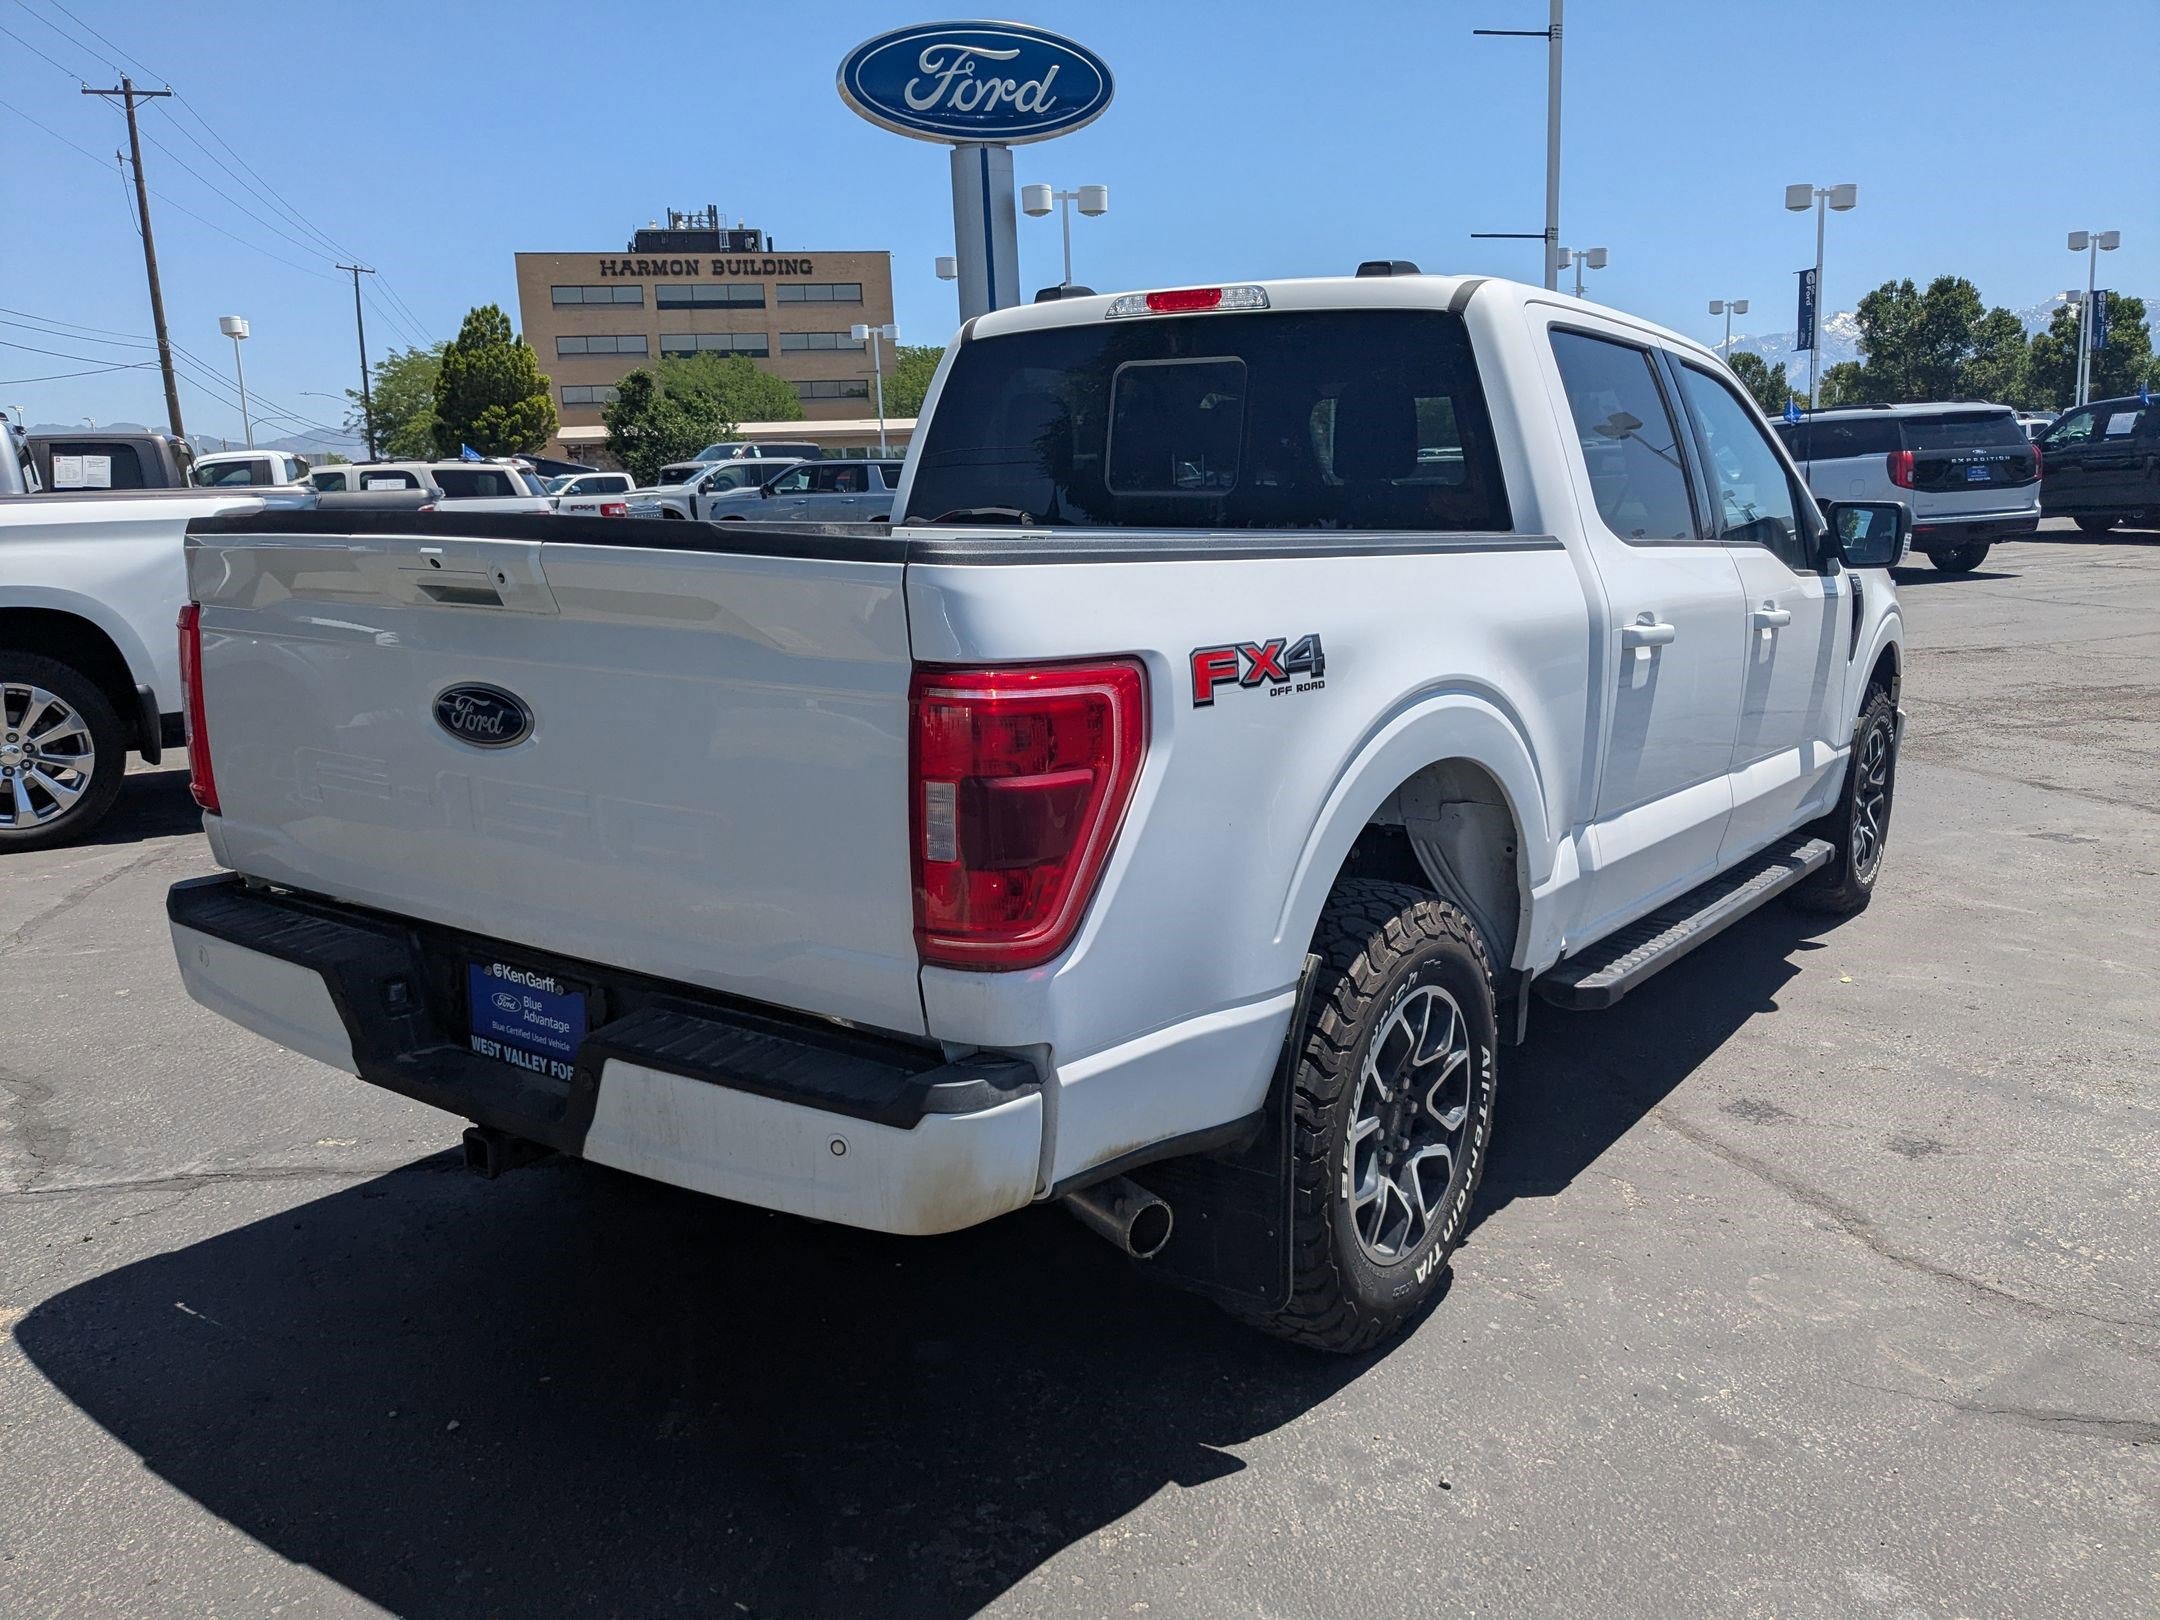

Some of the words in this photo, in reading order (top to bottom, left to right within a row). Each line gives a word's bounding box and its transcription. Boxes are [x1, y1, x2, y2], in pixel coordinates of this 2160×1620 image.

[904, 44, 1060, 113] Ford
[600, 259, 700, 276] HARMON
[711, 259, 814, 275] BUILDING
[1951, 455, 2011, 463] EXPEDITION
[1189, 633, 1326, 709] FX4
[1269, 685, 1293, 697] OFF
[1296, 680, 1326, 693] ROAD
[451, 695, 505, 735] Ford
[497, 994, 516, 1010] Ford
[523, 996, 543, 1011] Blue
[492, 1021, 505, 1032] Blue
[506, 1025, 531, 1040] Certified
[531, 1033, 547, 1044] Used
[548, 1038, 571, 1051] Vehicle
[523, 1010, 570, 1033] Advantage
[471, 1035, 502, 1058] WEST
[503, 1046, 548, 1073] VALLEY
[1341, 971, 1418, 1197] BFGoodrich
[1443, 1045, 1491, 1243] All-Terrain
[1414, 1242, 1444, 1284] T/A
